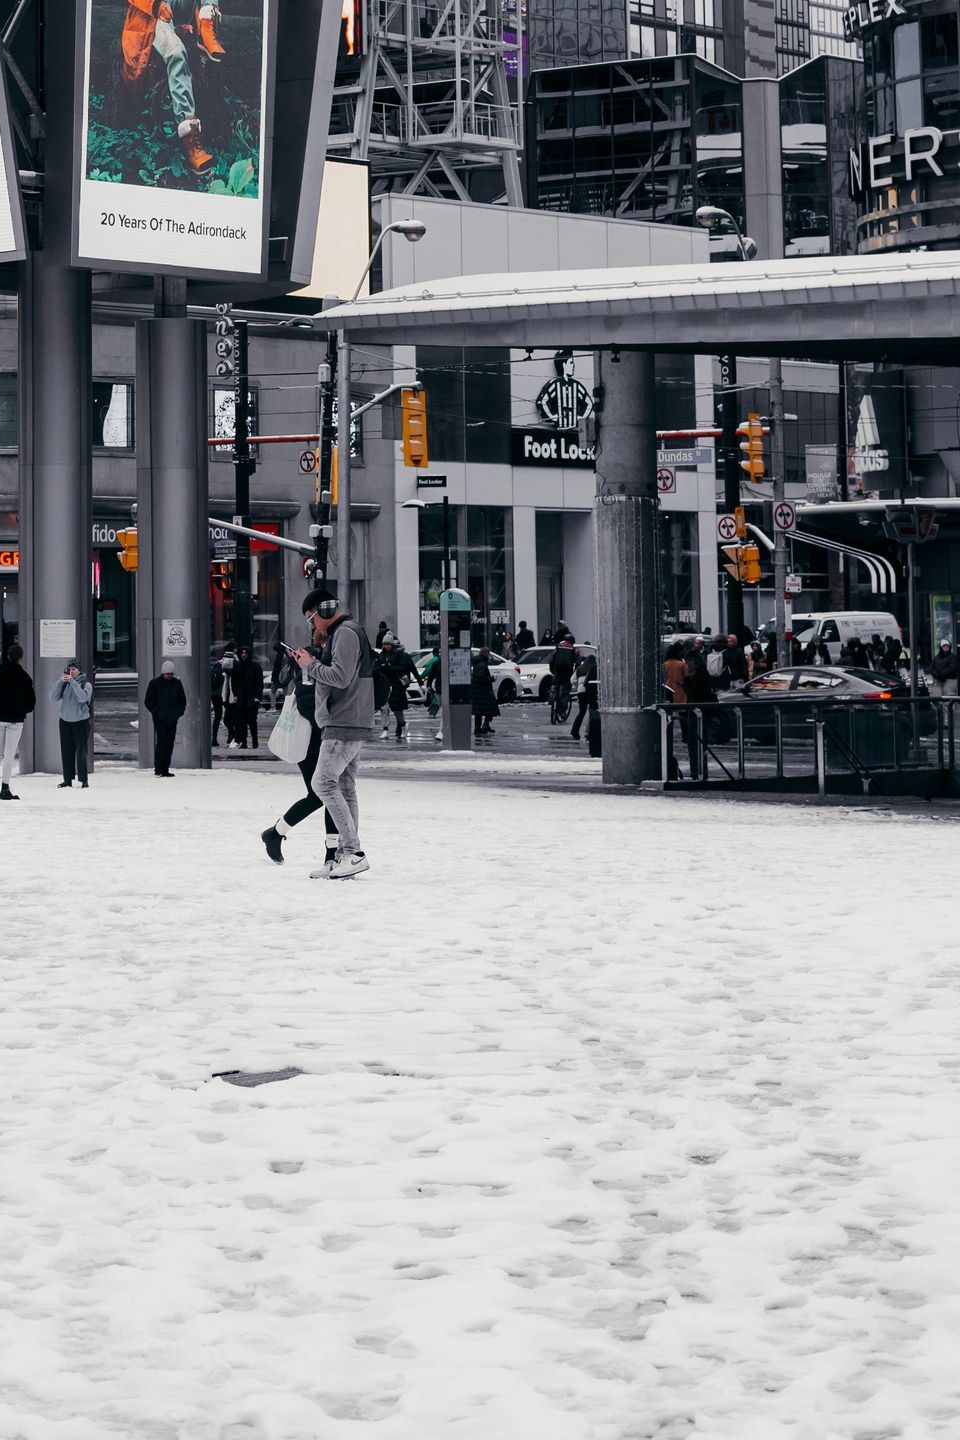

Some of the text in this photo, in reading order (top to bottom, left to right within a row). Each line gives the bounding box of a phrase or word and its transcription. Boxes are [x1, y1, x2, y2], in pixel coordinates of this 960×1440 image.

[849, 127, 960, 196] NER
[100, 212, 247, 240] 20 Years Of The Adirondack
[524, 435, 596, 460] Foot Lock
[658, 451, 693, 461] Dundas
[92, 524, 116, 543] fido
